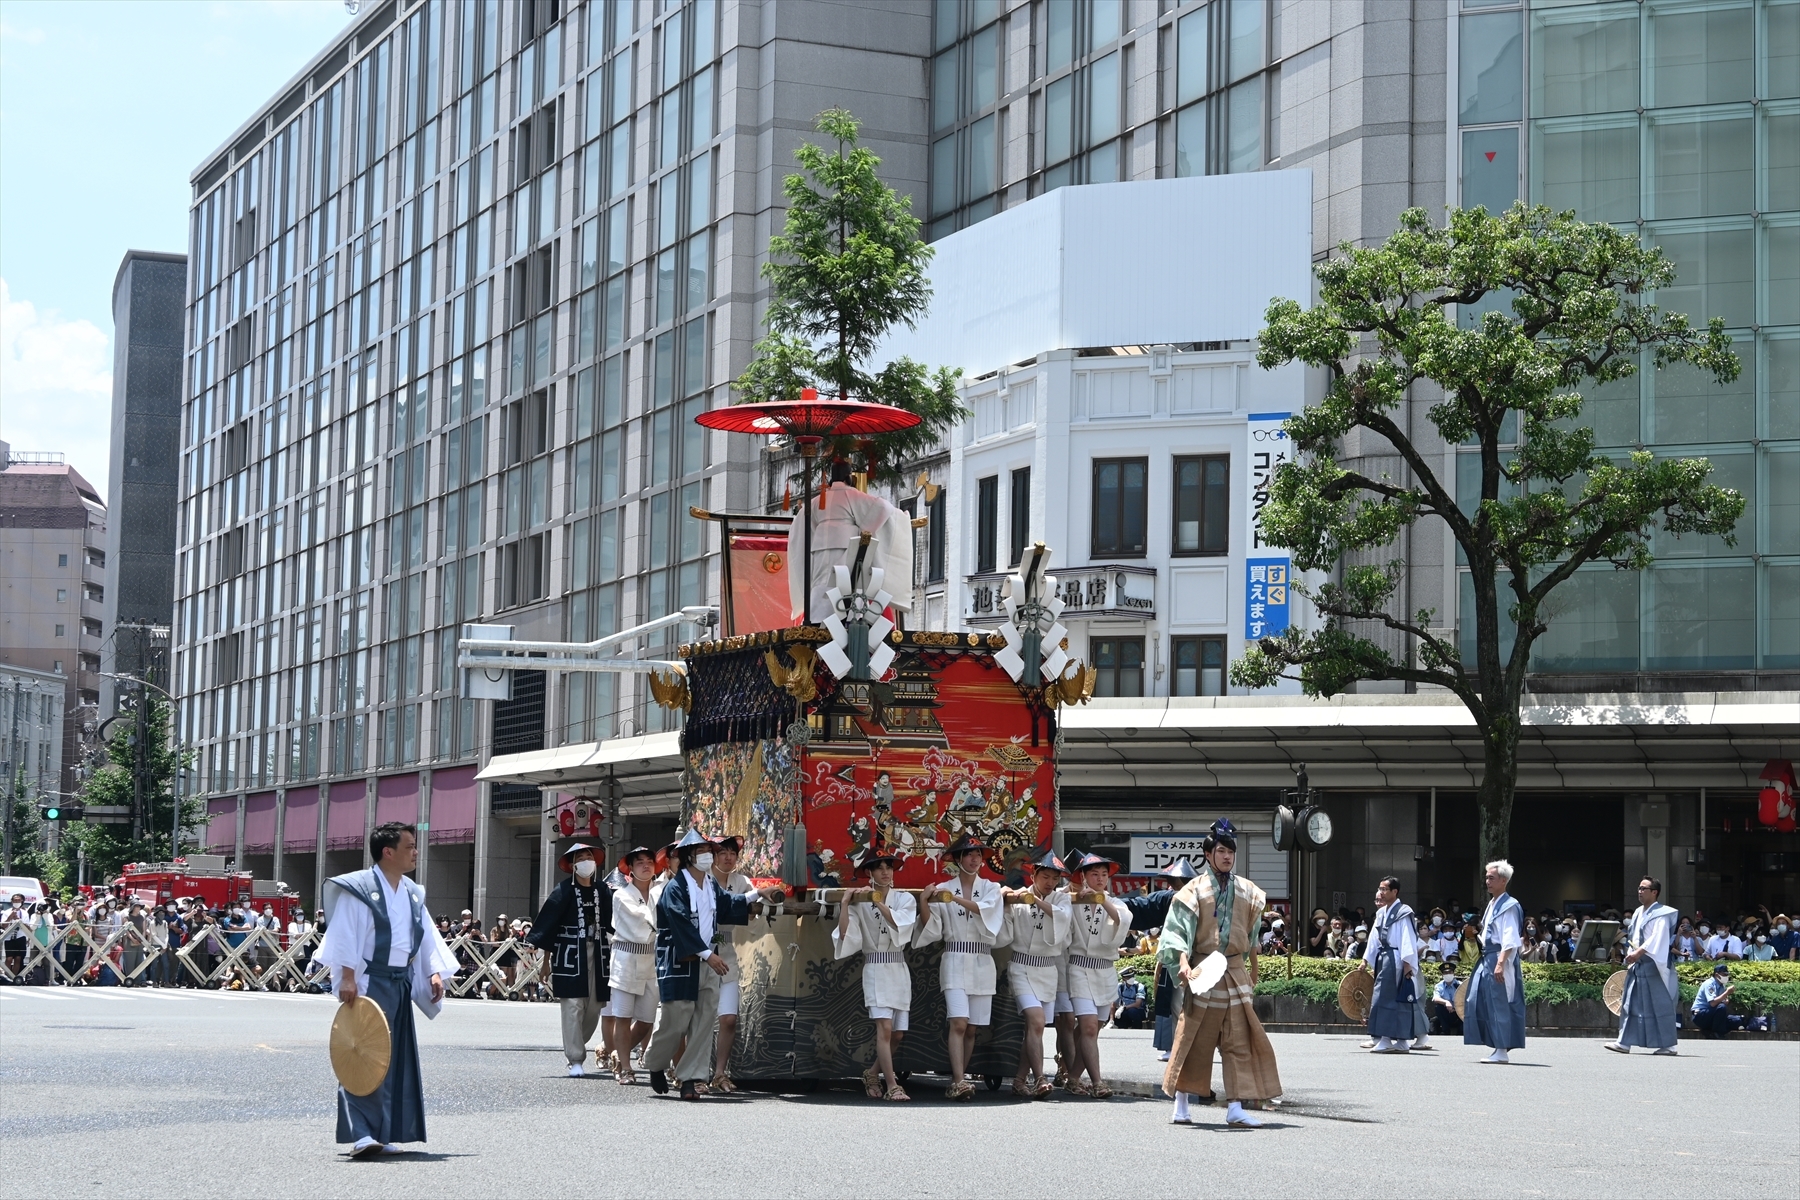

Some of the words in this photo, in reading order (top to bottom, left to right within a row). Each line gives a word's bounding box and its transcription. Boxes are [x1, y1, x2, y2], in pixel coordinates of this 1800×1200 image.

[1250, 566, 1266, 637] 買えます
[1269, 566, 1284, 603] すぐ
[1091, 907, 1102, 936] 太子山
